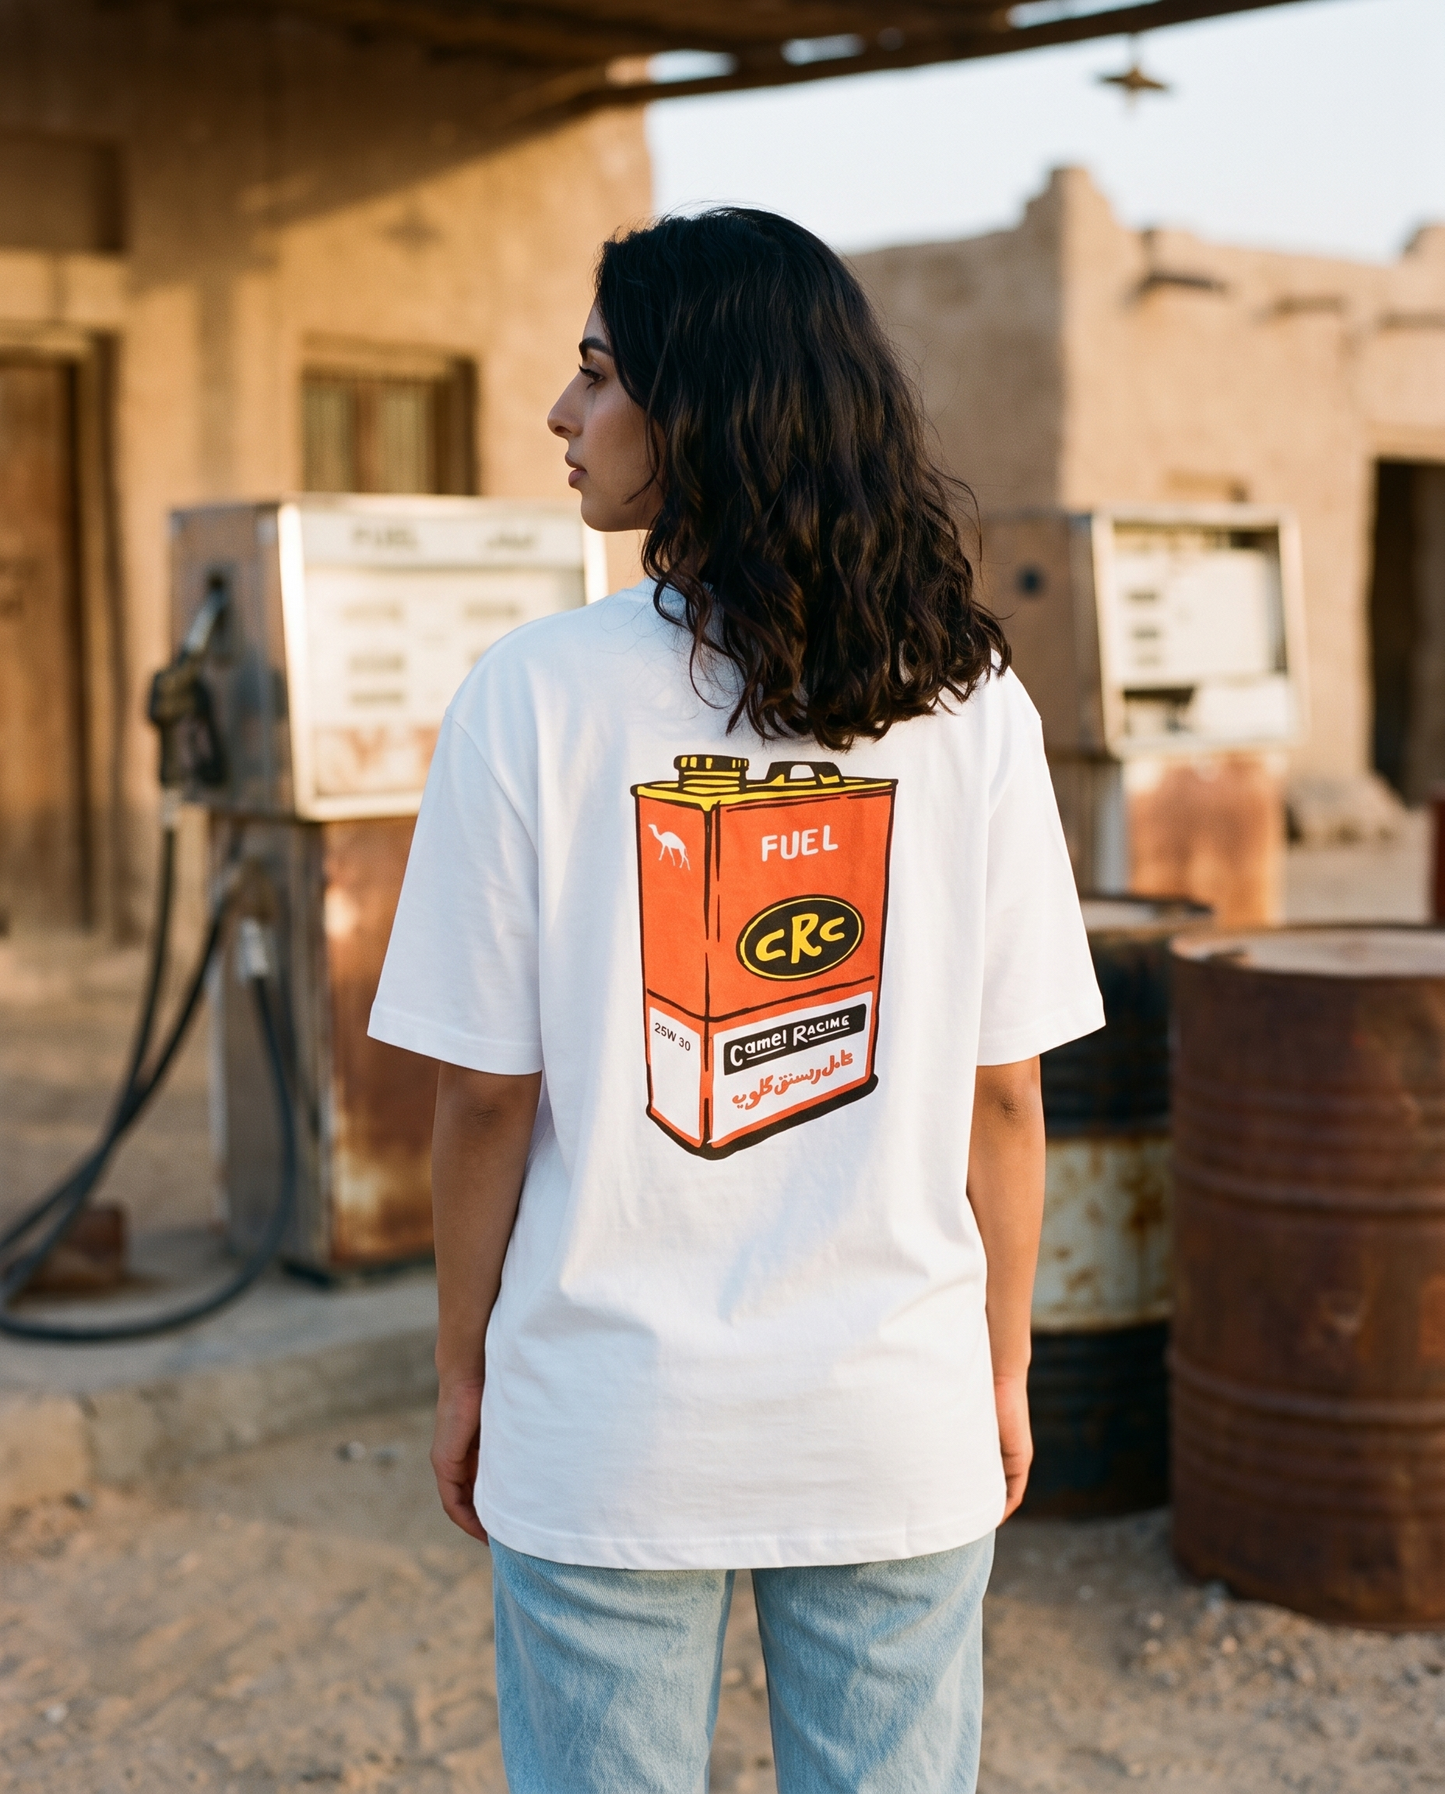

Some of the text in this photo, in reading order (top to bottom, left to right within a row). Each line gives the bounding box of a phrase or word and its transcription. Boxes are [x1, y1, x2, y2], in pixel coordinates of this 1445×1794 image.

[761, 825, 839, 862] FUEL
[654, 1022, 691, 1052] 25W 30
[730, 1029, 787, 1067] Camel
